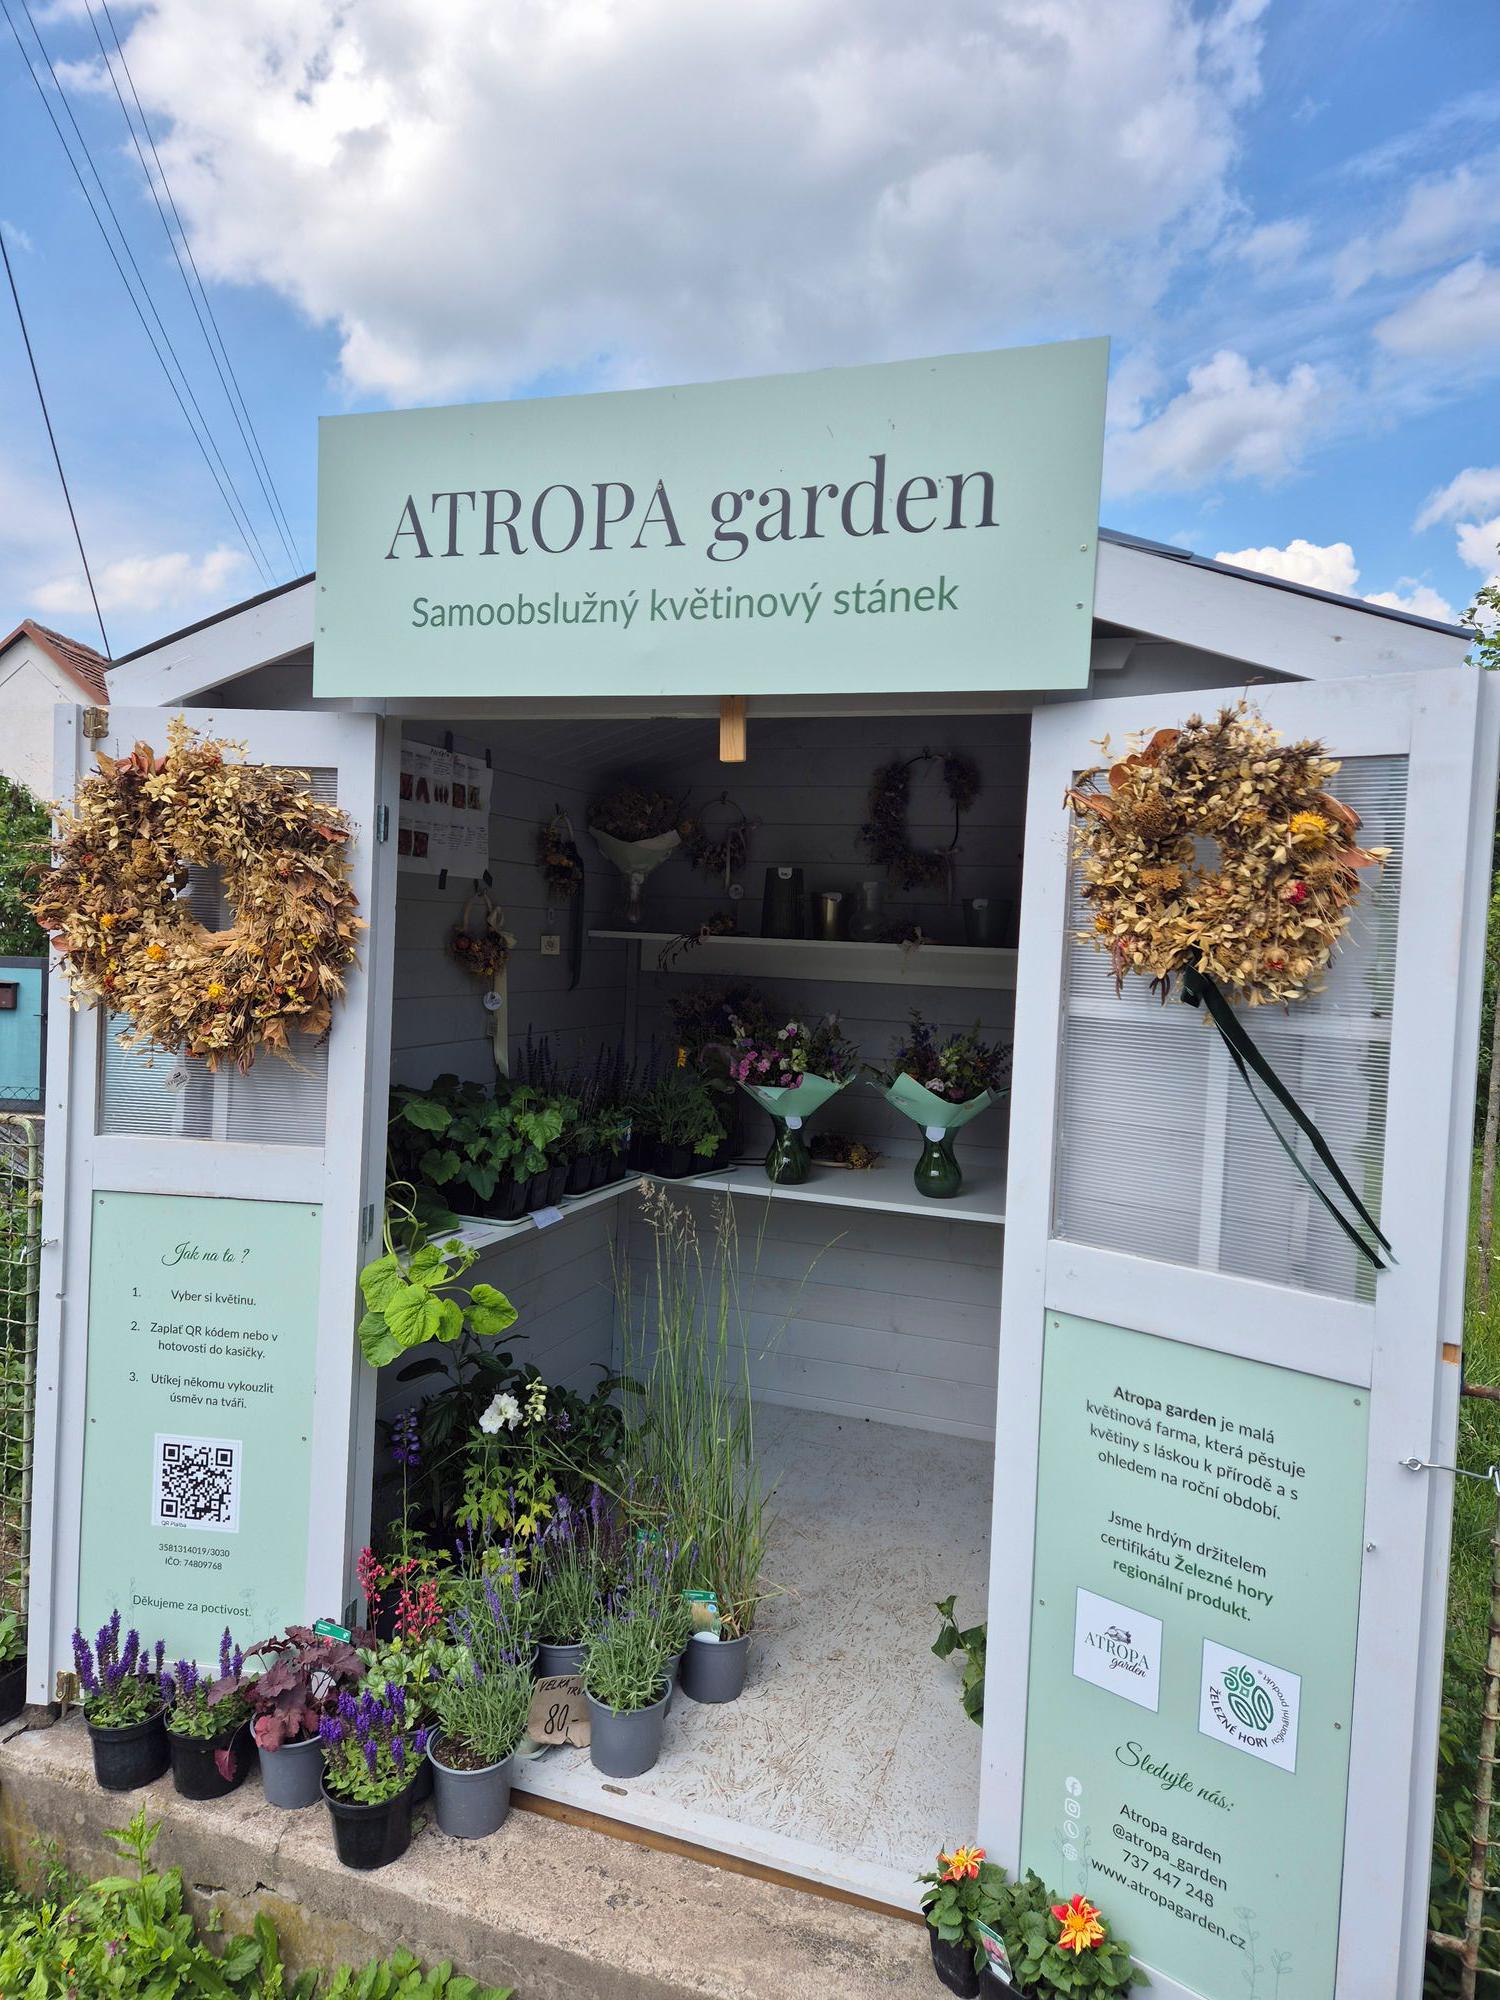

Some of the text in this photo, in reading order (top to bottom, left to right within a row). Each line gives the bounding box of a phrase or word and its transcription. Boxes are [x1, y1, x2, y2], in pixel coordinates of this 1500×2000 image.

[385, 454, 1000, 562] ATROPA garden
[411, 575, 959, 630] Samoobslužný květinový stánek
[161, 1241, 250, 1266] Jak na to ?
[132, 1288, 256, 1306] 1. Vyber si květinu.
[131, 1321, 278, 1342] 2. Zaplať QR kódem nebo v
[158, 1340, 265, 1359] hotovosti do kasičky.
[129, 1372, 274, 1394] 3. Utíkej někomu vykouzlit
[170, 1393, 247, 1408] úsměv na tváři.
[1086, 1399, 1306, 1478] květinová farma, která pěstuje
[1113, 1385, 1275, 1443] Atropa garden je malá
[1090, 1424, 1299, 1501] květiny s láskou k přírodě a s
[1098, 1449, 1281, 1520] ohledem na roční období.
[158, 1543, 230, 1557] 3581314019/3030
[165, 1557, 222, 1570] IČO: 74809768
[1100, 1530, 1274, 1606] certifikátu Železné hory
[1107, 1510, 1267, 1577] Jsme hrdým držitelem
[133, 1594, 251, 1617] Děkujeme za poctivost.
[1113, 1557, 1251, 1621] regionální produkt.
[1084, 1631, 1150, 1670] ATROPA
[1108, 1656, 1147, 1678] garden
[1209, 1685, 1269, 1748] ŽELEZNÉ HORY
[1262, 1672, 1290, 1744] regionální produkt
[1115, 1741, 1235, 1811] Sledujte nás:
[1112, 1824, 1228, 1891] @atropa_garden
[1119, 1804, 1223, 1864] Atropa garden
[1090, 1858, 1247, 1950] www.atropagarden.cz
[1122, 1849, 1215, 1907] 737 447 248
